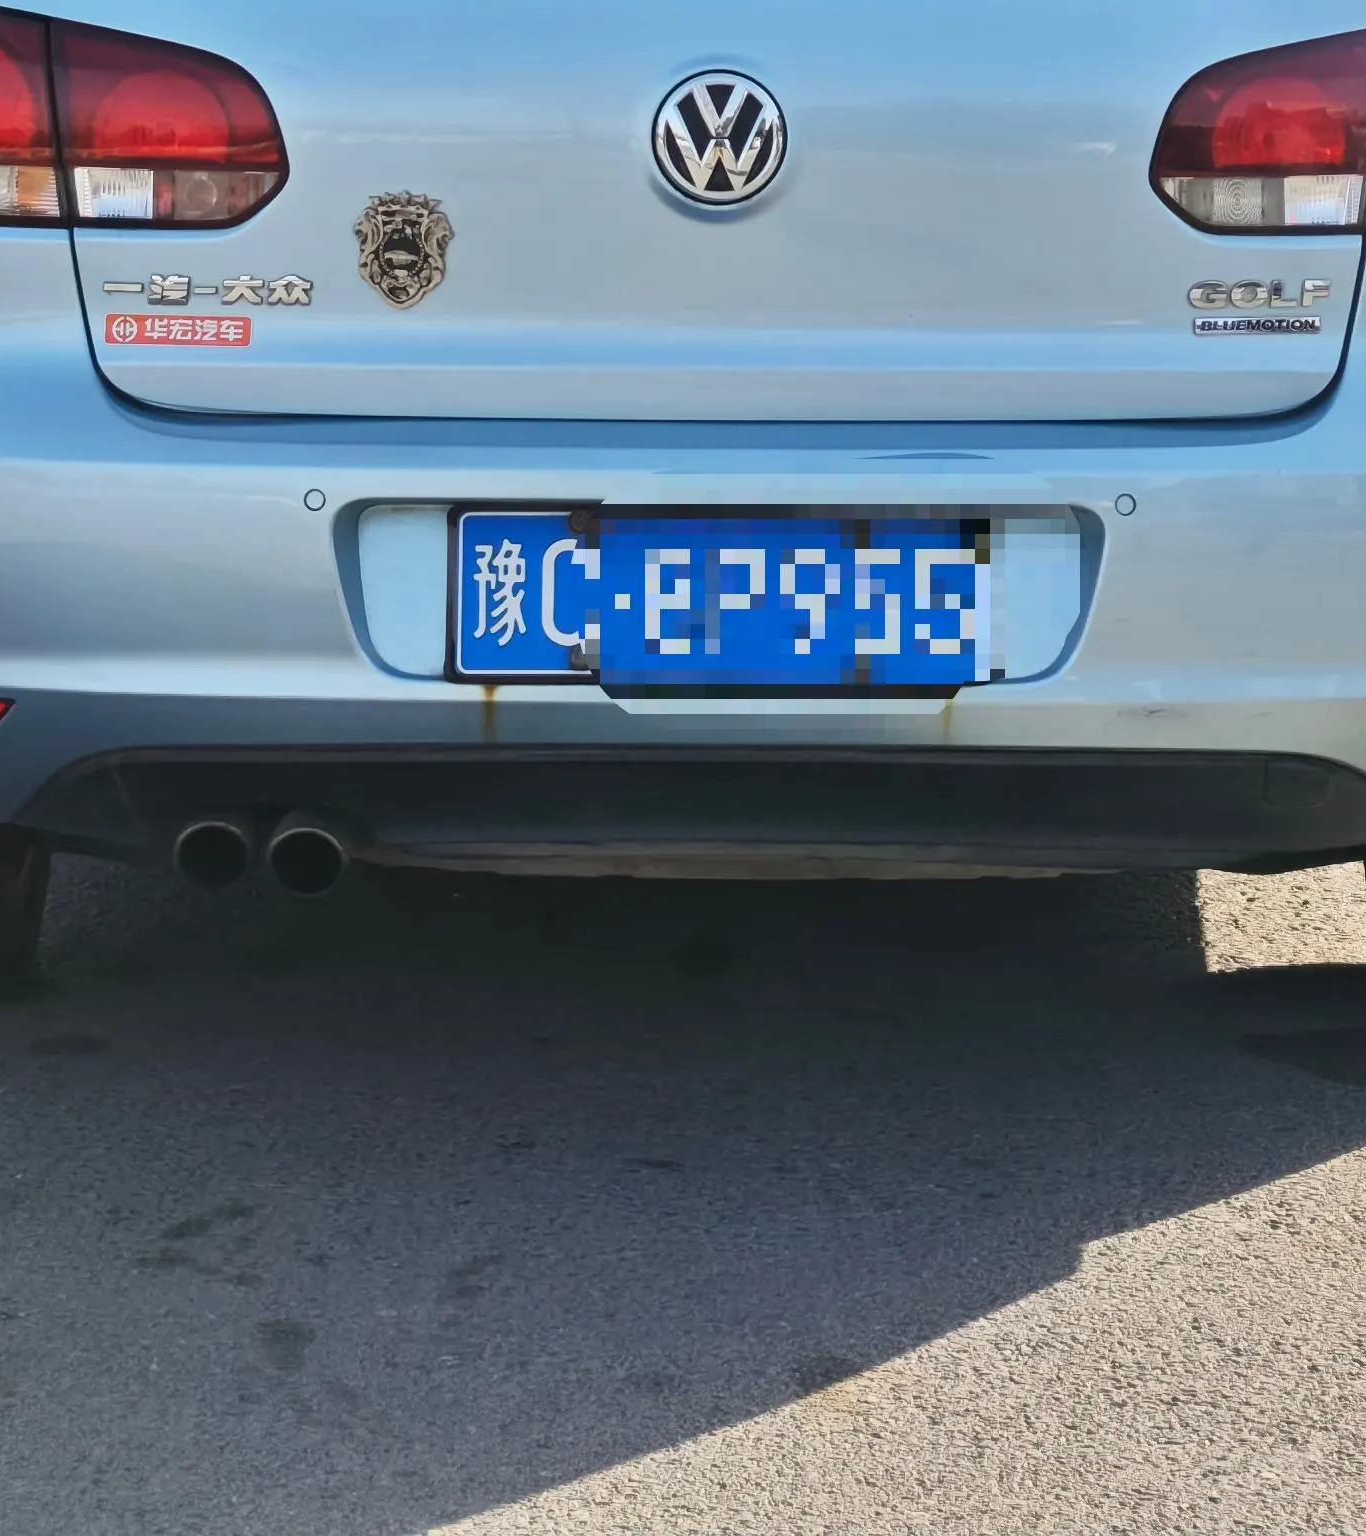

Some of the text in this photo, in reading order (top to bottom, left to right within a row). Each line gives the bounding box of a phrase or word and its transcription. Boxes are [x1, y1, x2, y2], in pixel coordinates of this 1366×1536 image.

[1187, 278, 1333, 310] GOLF
[144, 317, 244, 342] 华宏汽车
[1197, 318, 1319, 334] BLUEMOTION
